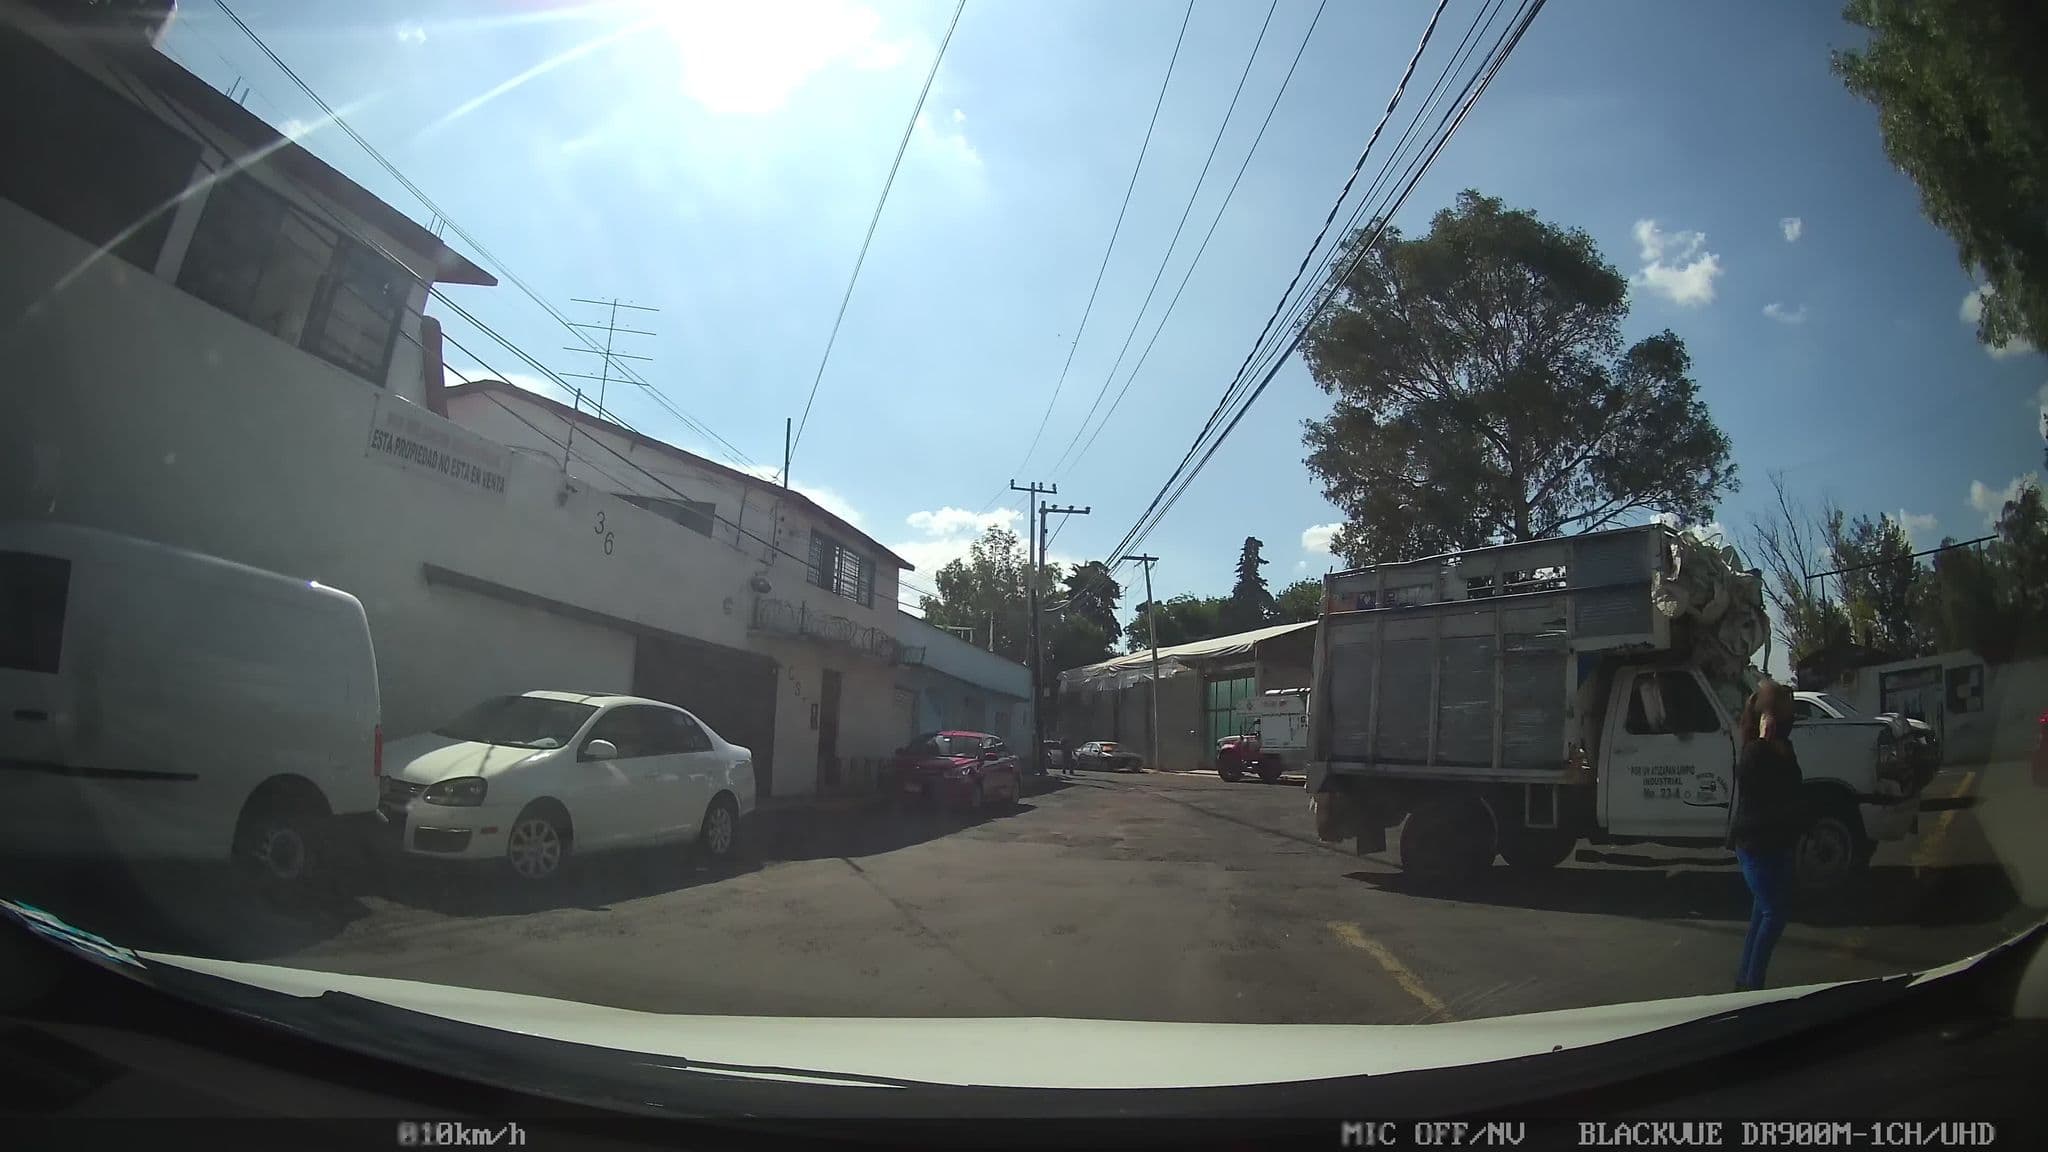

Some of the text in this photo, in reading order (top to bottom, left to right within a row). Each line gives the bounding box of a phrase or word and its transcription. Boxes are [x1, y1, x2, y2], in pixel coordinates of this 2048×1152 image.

[371, 429, 394, 455] ESTA
[393, 437, 438, 469] PROPIEDAD
[438, 453, 450, 474] NO
[451, 458, 470, 482] ESTA
[470, 465, 481, 484] EN
[482, 471, 505, 494] VENTA
[1642, 777, 1683, 786] INDUSTRIAL
